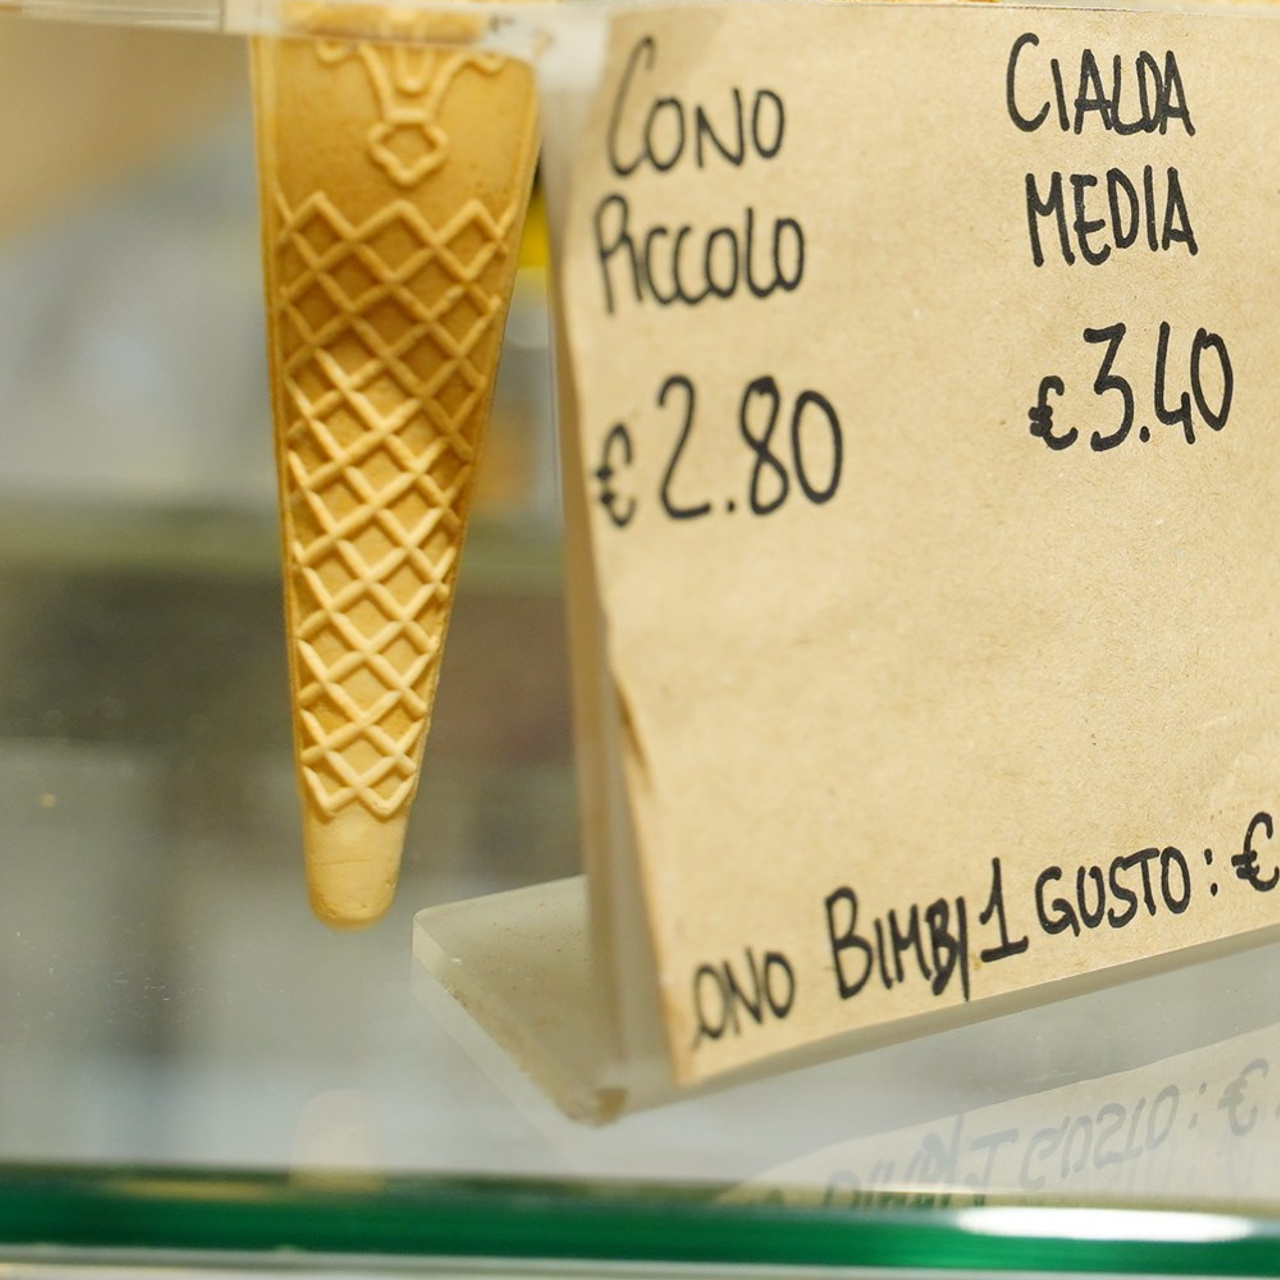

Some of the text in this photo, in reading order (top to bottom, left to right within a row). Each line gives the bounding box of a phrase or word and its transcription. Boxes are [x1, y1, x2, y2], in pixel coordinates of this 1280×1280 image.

[607, 34, 784, 176] CONO
[1005, 32, 1196, 134] CIALDA
[592, 193, 805, 315] PICCOLO
[1025, 165, 1198, 267] MEDIA
[825, 886, 969, 1002] BIMBI
[978, 857, 1028, 963] 1
